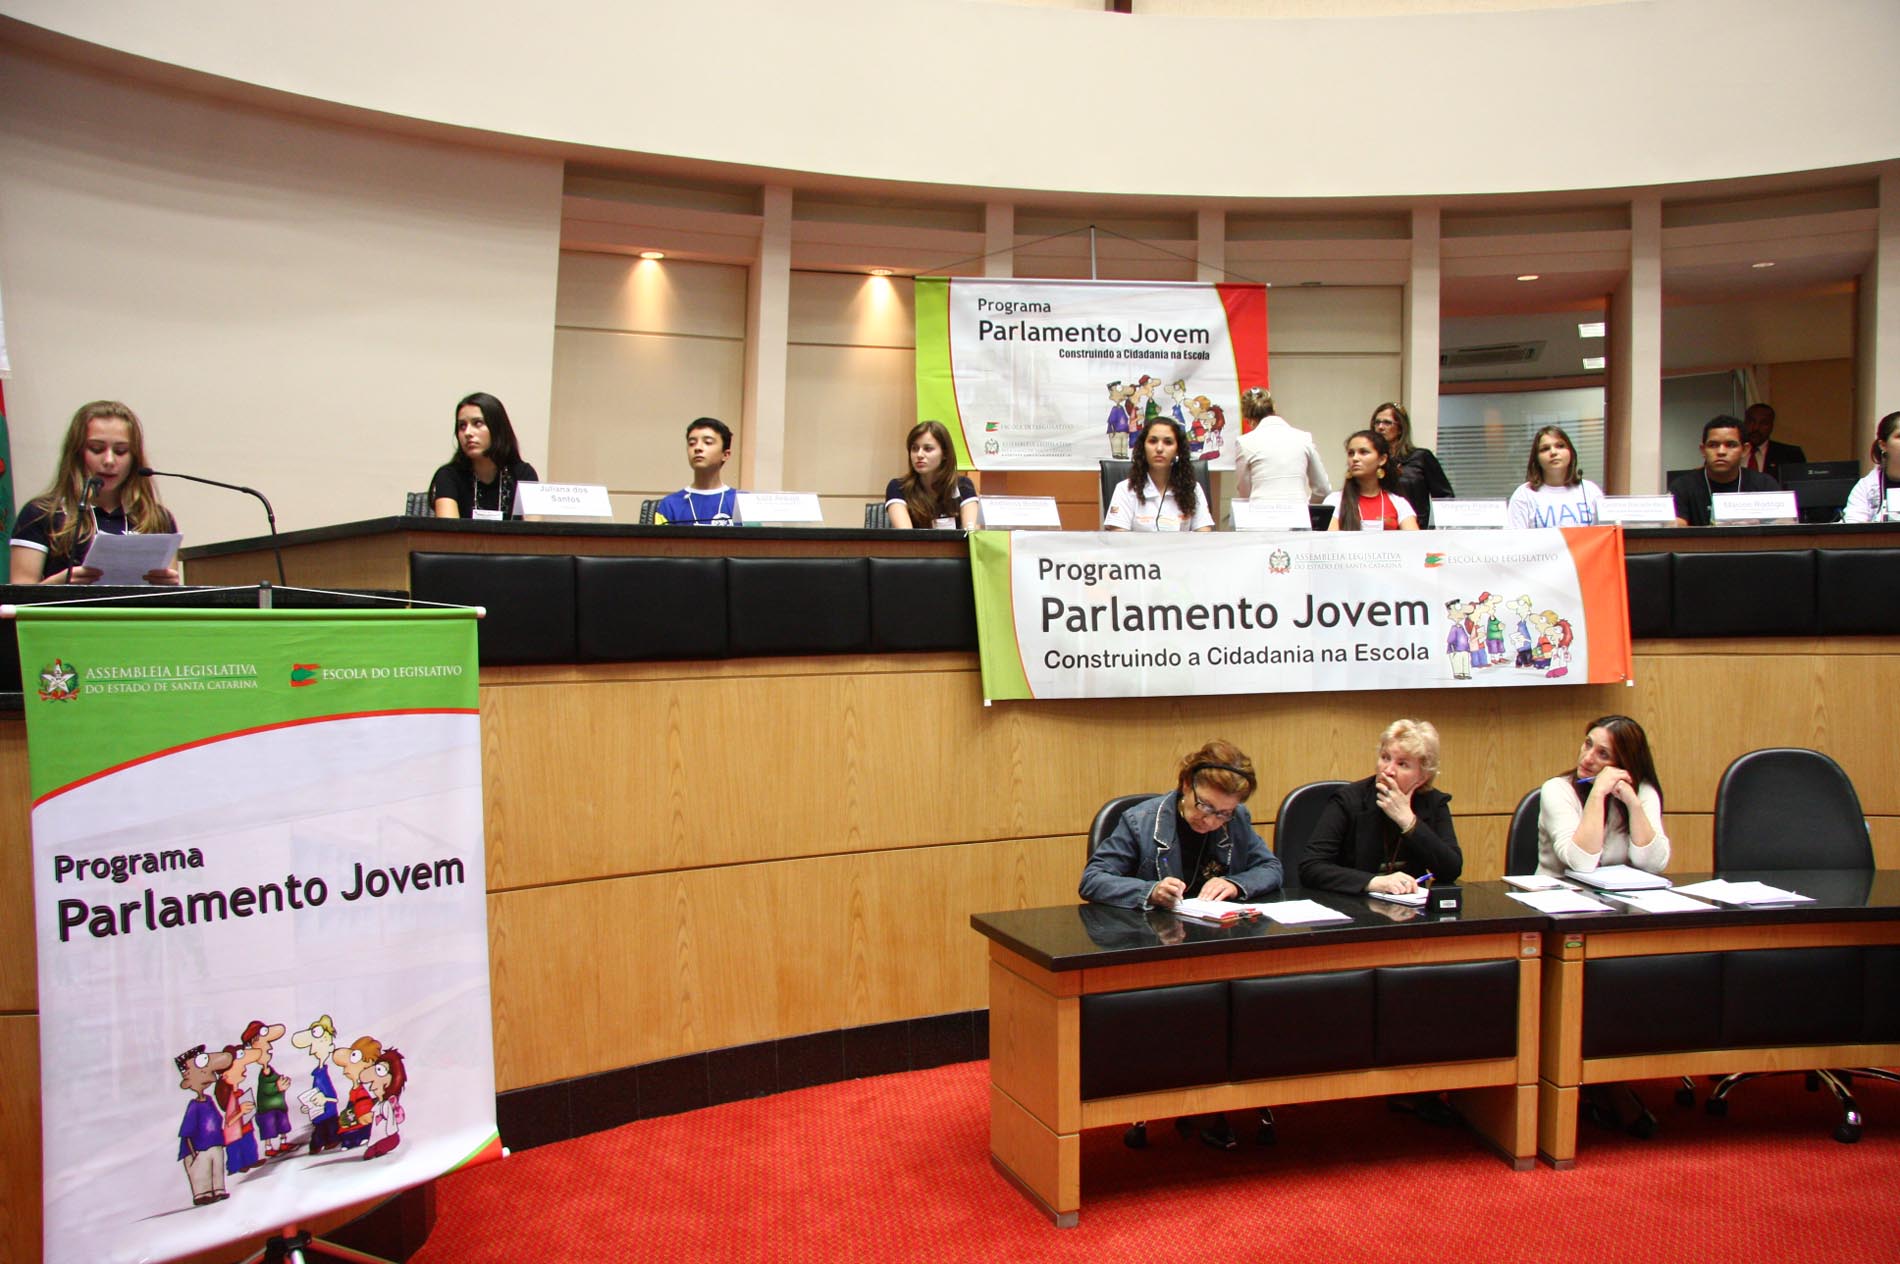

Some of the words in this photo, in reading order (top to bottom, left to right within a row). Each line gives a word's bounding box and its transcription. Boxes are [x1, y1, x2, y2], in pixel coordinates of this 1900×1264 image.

[977, 298, 1052, 315] Programa
[979, 320, 1122, 343] Parlamento
[1130, 323, 1210, 344] Jovem
[1058, 348, 1115, 359] Construindo
[1116, 350, 1122, 359] a
[1123, 348, 1169, 360] Cidadania
[1170, 350, 1182, 360] na
[1183, 349, 1210, 361] Escola
[1447, 555, 1482, 565] ESCOLA
[1501, 553, 1558, 563] LEGISLATIVO
[1039, 558, 1162, 587] Programa
[1042, 595, 1279, 633] Parlamento
[1293, 594, 1430, 629] Jovem
[1044, 648, 1182, 670] Construindo
[1188, 652, 1202, 666] a
[1207, 645, 1316, 666] Cidadania
[1321, 648, 1348, 663] na
[1355, 642, 1430, 662] Escola
[86, 666, 171, 680] ASSEMBLEIA
[176, 663, 257, 678] LEGISLATIVA
[322, 669, 368, 680] ESCOLA
[371, 667, 391, 679] DO
[393, 665, 463, 679] LEGISLATIVO
[85, 684, 104, 695] DO
[107, 683, 151, 694] ESTADO
[153, 682, 168, 692] DE
[171, 681, 205, 692] SANTA
[207, 680, 258, 690] CATARINA
[54, 847, 205, 884] Programa
[56, 873, 328, 943] Parlamento
[340, 857, 465, 902] Jovem
